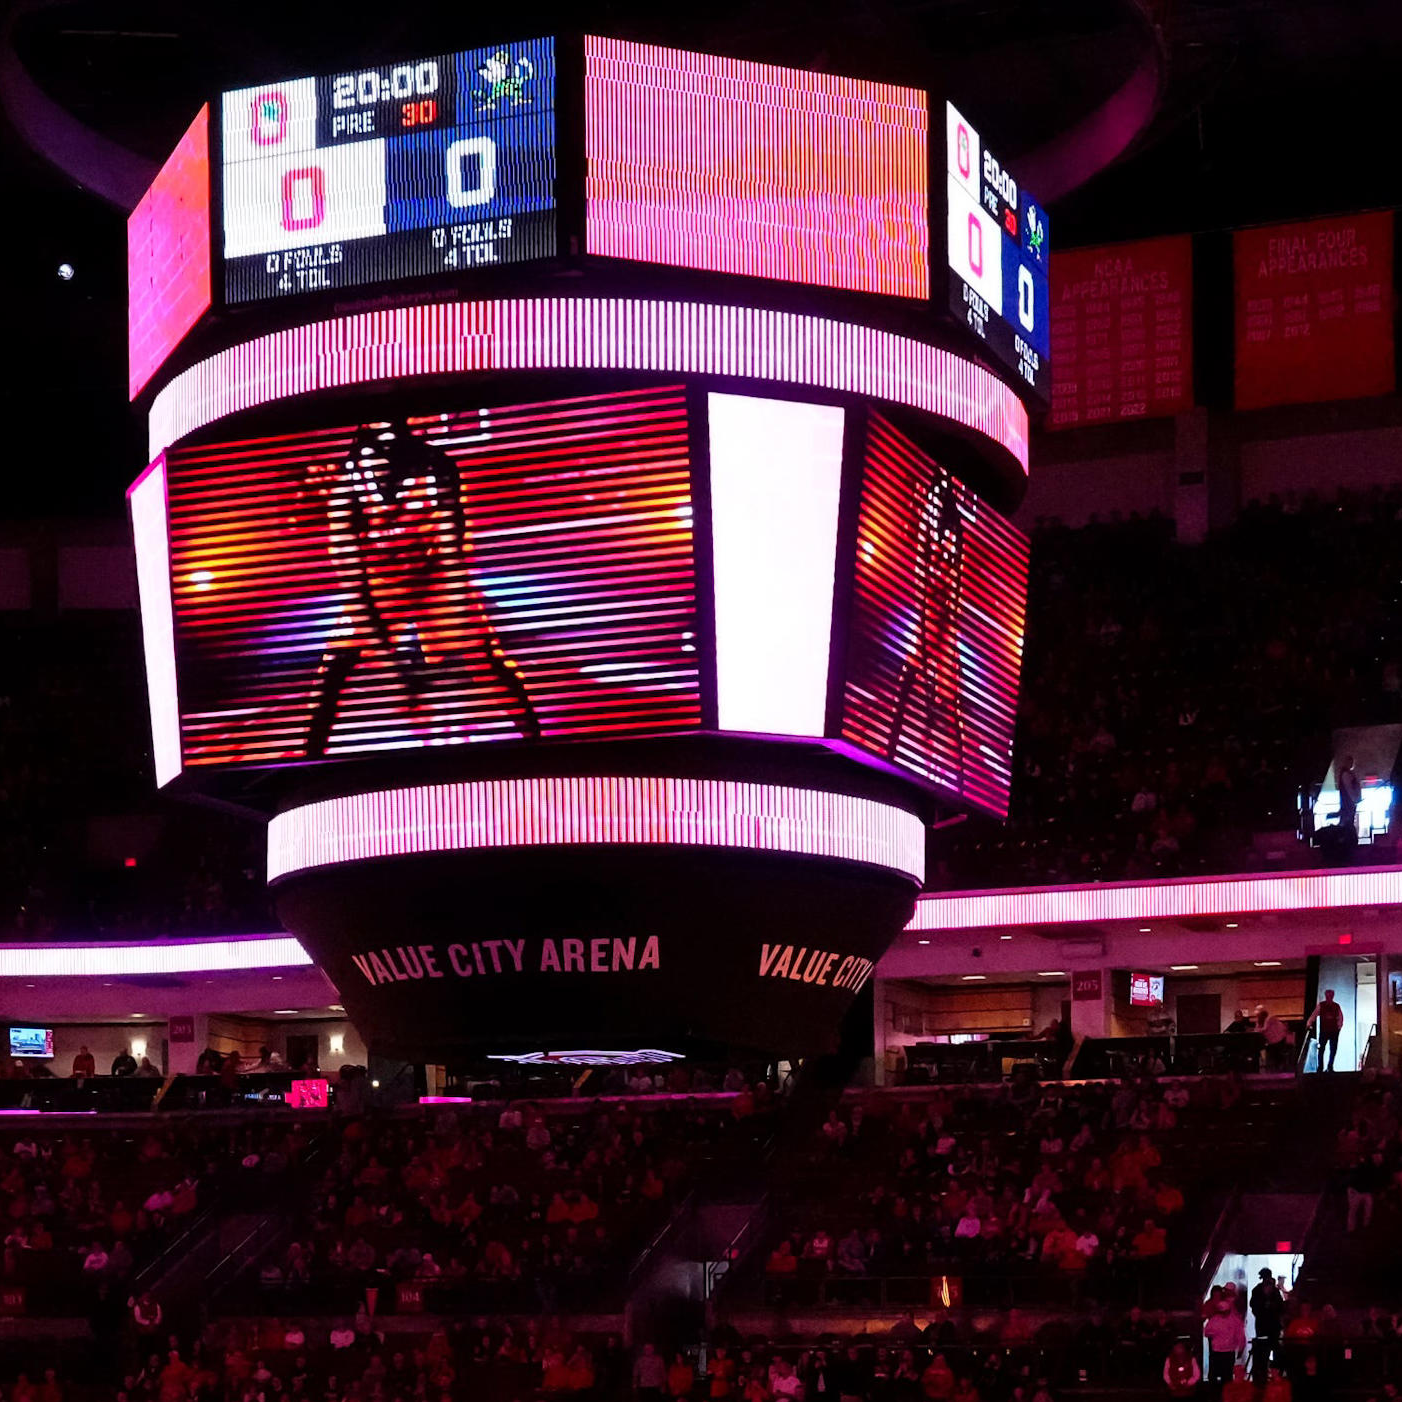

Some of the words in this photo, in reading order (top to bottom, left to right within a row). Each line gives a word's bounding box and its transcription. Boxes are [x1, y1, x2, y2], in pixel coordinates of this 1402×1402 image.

[333, 61, 439, 108] 20:00
[332, 111, 375, 137] PRE
[402, 100, 437, 127] 30
[280, 166, 325, 232] 0
[447, 136, 497, 208] 0
[984, 150, 1017, 210] 20:00
[968, 211, 982, 278] 0
[1018, 264, 1034, 333] 0
[352, 942, 443, 987] VALUE
[448, 938, 526, 979] CITY
[540, 935, 660, 973] ARENA
[758, 942, 837, 988] VALUE
[1077, 980, 1099, 991] 205
